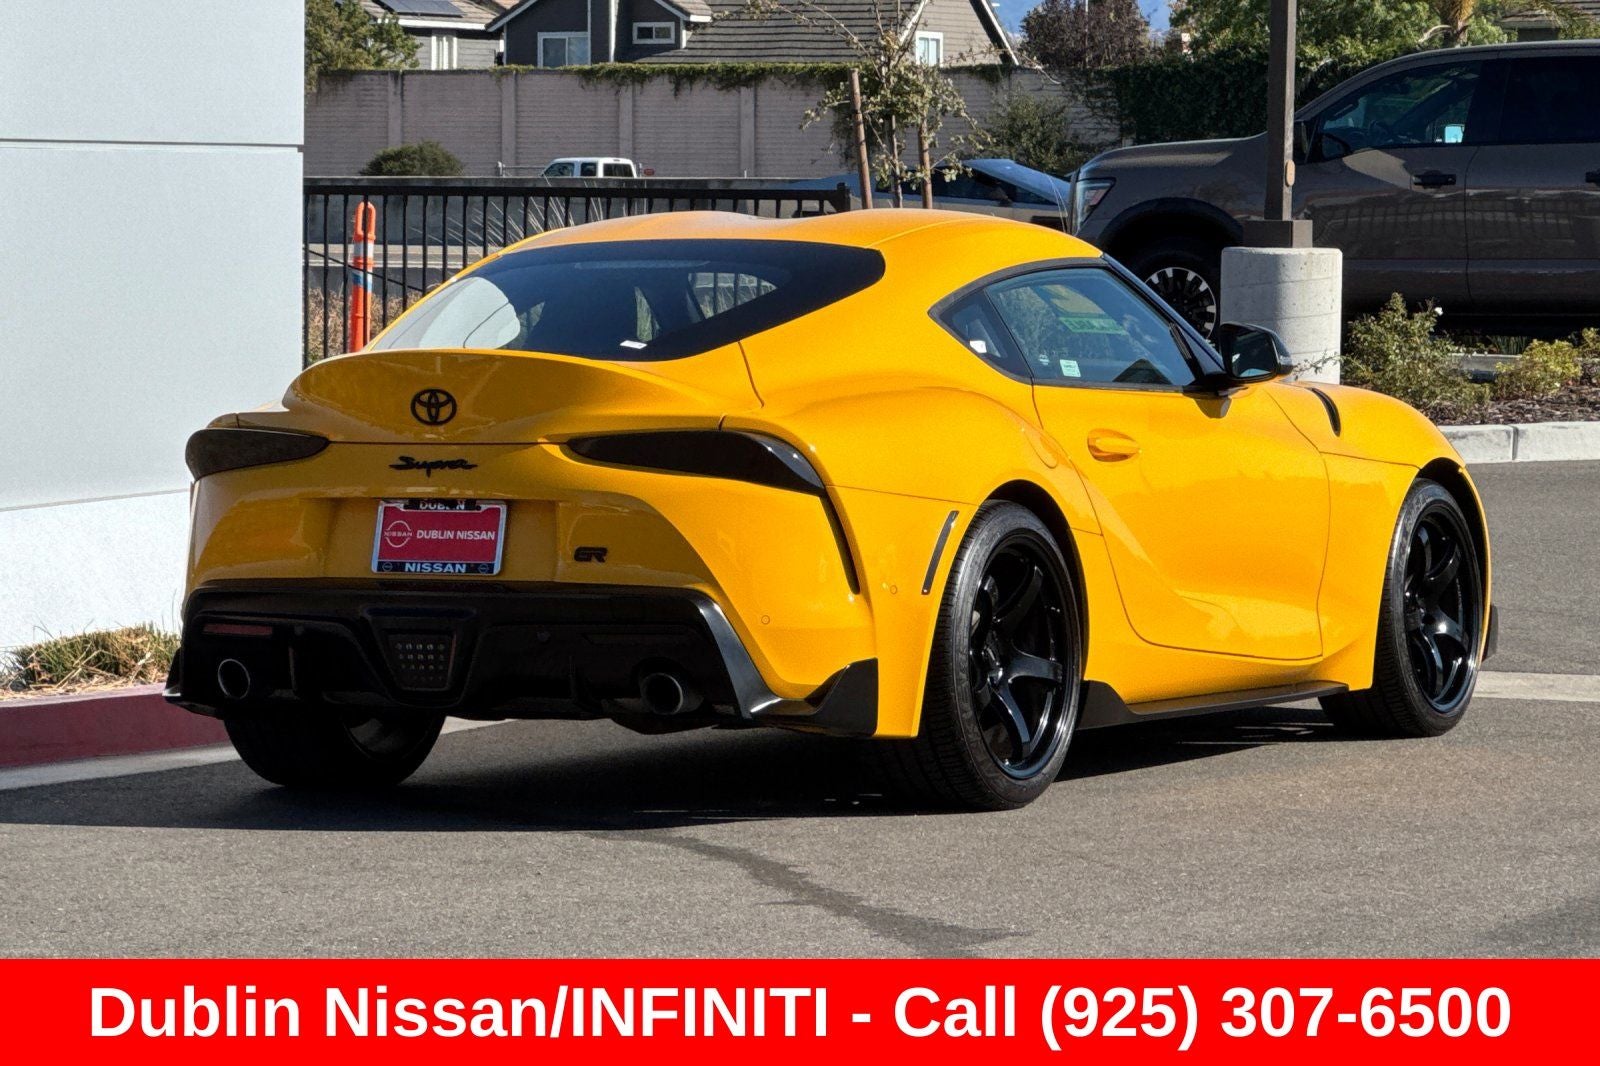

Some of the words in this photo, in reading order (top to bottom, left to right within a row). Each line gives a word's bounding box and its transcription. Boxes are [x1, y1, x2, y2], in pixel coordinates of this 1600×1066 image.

[388, 456, 478, 478] Supra
[419, 501, 465, 510] DUBN
[416, 529, 454, 540] DUBLIN
[456, 530, 496, 541] NISSAN
[574, 546, 608, 563] GR
[404, 562, 466, 573] NISSAN
